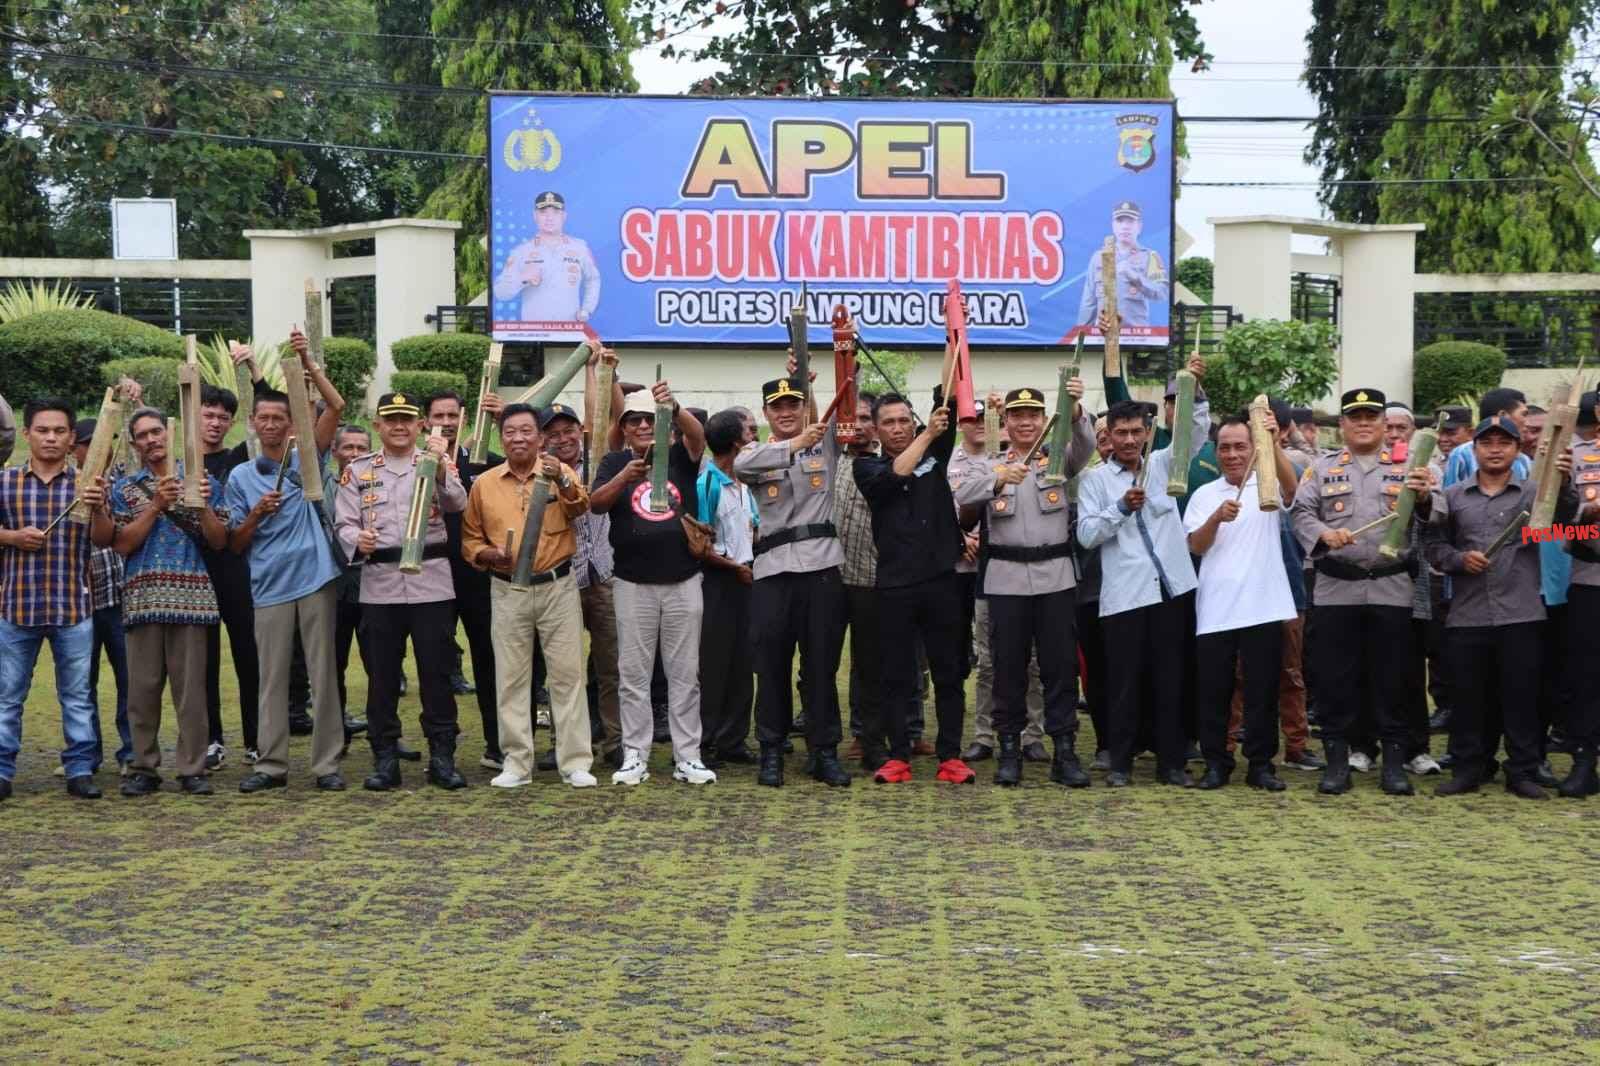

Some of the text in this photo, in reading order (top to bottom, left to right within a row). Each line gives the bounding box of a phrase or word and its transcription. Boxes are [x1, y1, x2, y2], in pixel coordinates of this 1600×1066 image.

[681, 118, 1005, 200] APEL
[622, 209, 1063, 284] SABUK KAMTIBMAS
[658, 291, 776, 324] POLRES
[930, 293, 1025, 326] UARA
